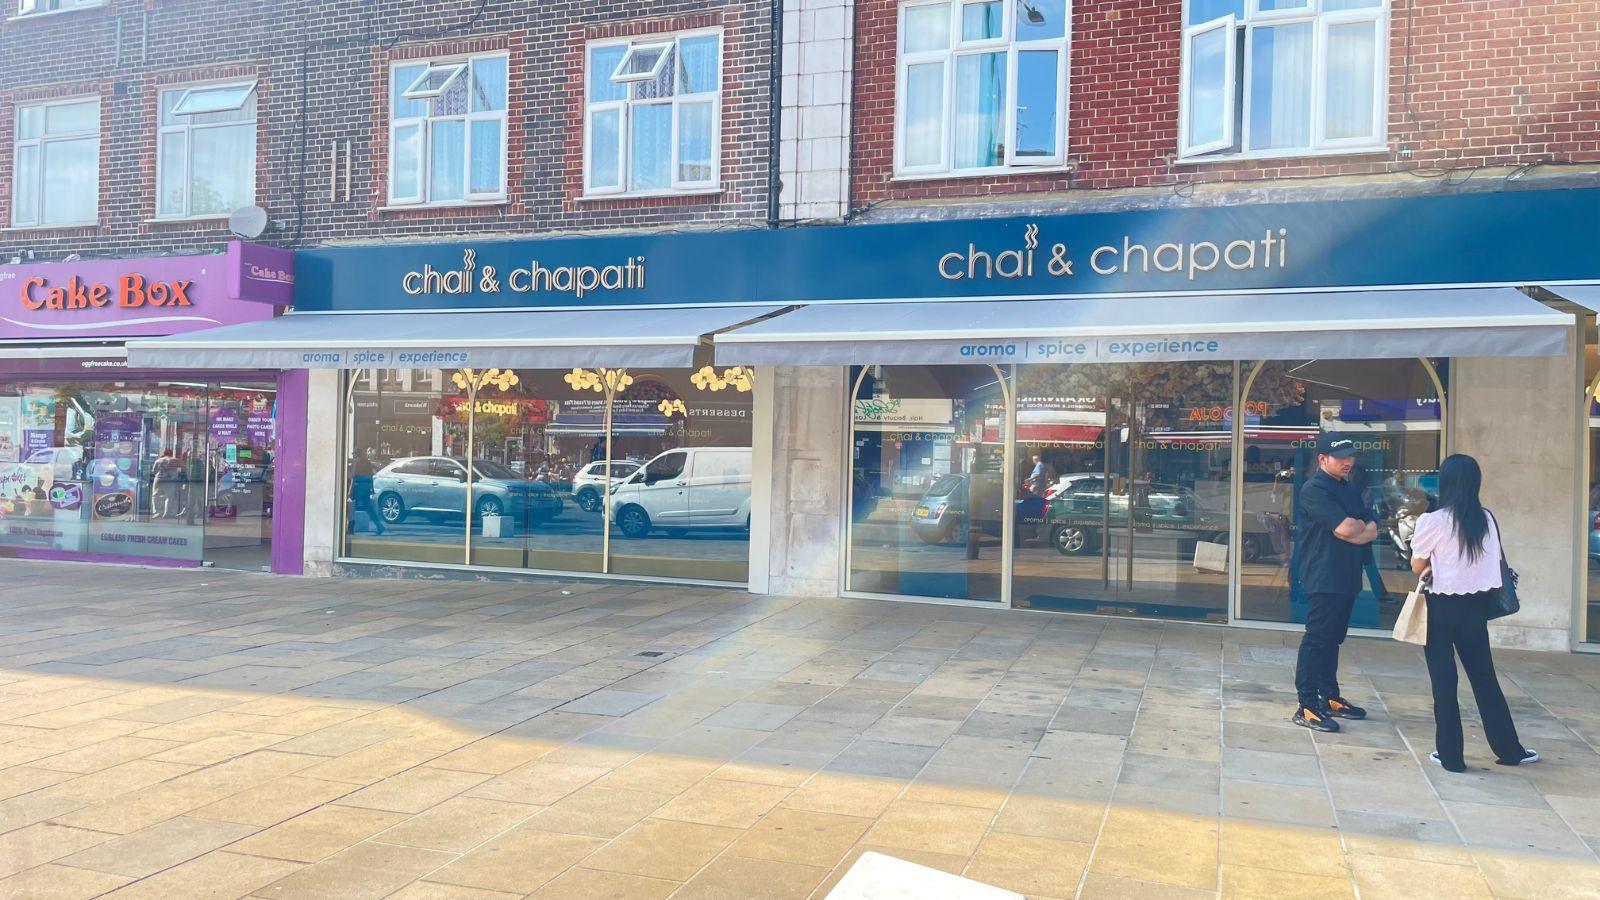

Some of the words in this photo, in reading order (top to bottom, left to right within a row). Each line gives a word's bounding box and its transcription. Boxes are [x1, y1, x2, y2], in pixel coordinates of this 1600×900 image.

[938, 232, 1036, 280] chai
[1047, 243, 1073, 277] &
[1090, 228, 1287, 281] chapati
[251, 266, 276, 278] Cake
[402, 256, 474, 294] chai
[479, 265, 500, 293] &
[509, 256, 645, 298] chapati
[21, 274, 113, 311] Cake
[119, 272, 196, 308] Box
[960, 343, 1016, 357] aroma
[1037, 340, 1087, 357] spice
[1108, 338, 1219, 357] experience
[302, 351, 340, 362] aroma
[352, 351, 385, 365] spice
[399, 350, 468, 365] experience
[482, 401, 518, 417] chapati
[381, 424, 398, 432] chai
[676, 428, 712, 438] chapati
[890, 431, 913, 441] chai
[1064, 438, 1104, 450] chapa
[1290, 438, 1317, 448] cha
[1353, 439, 1390, 451] apati
